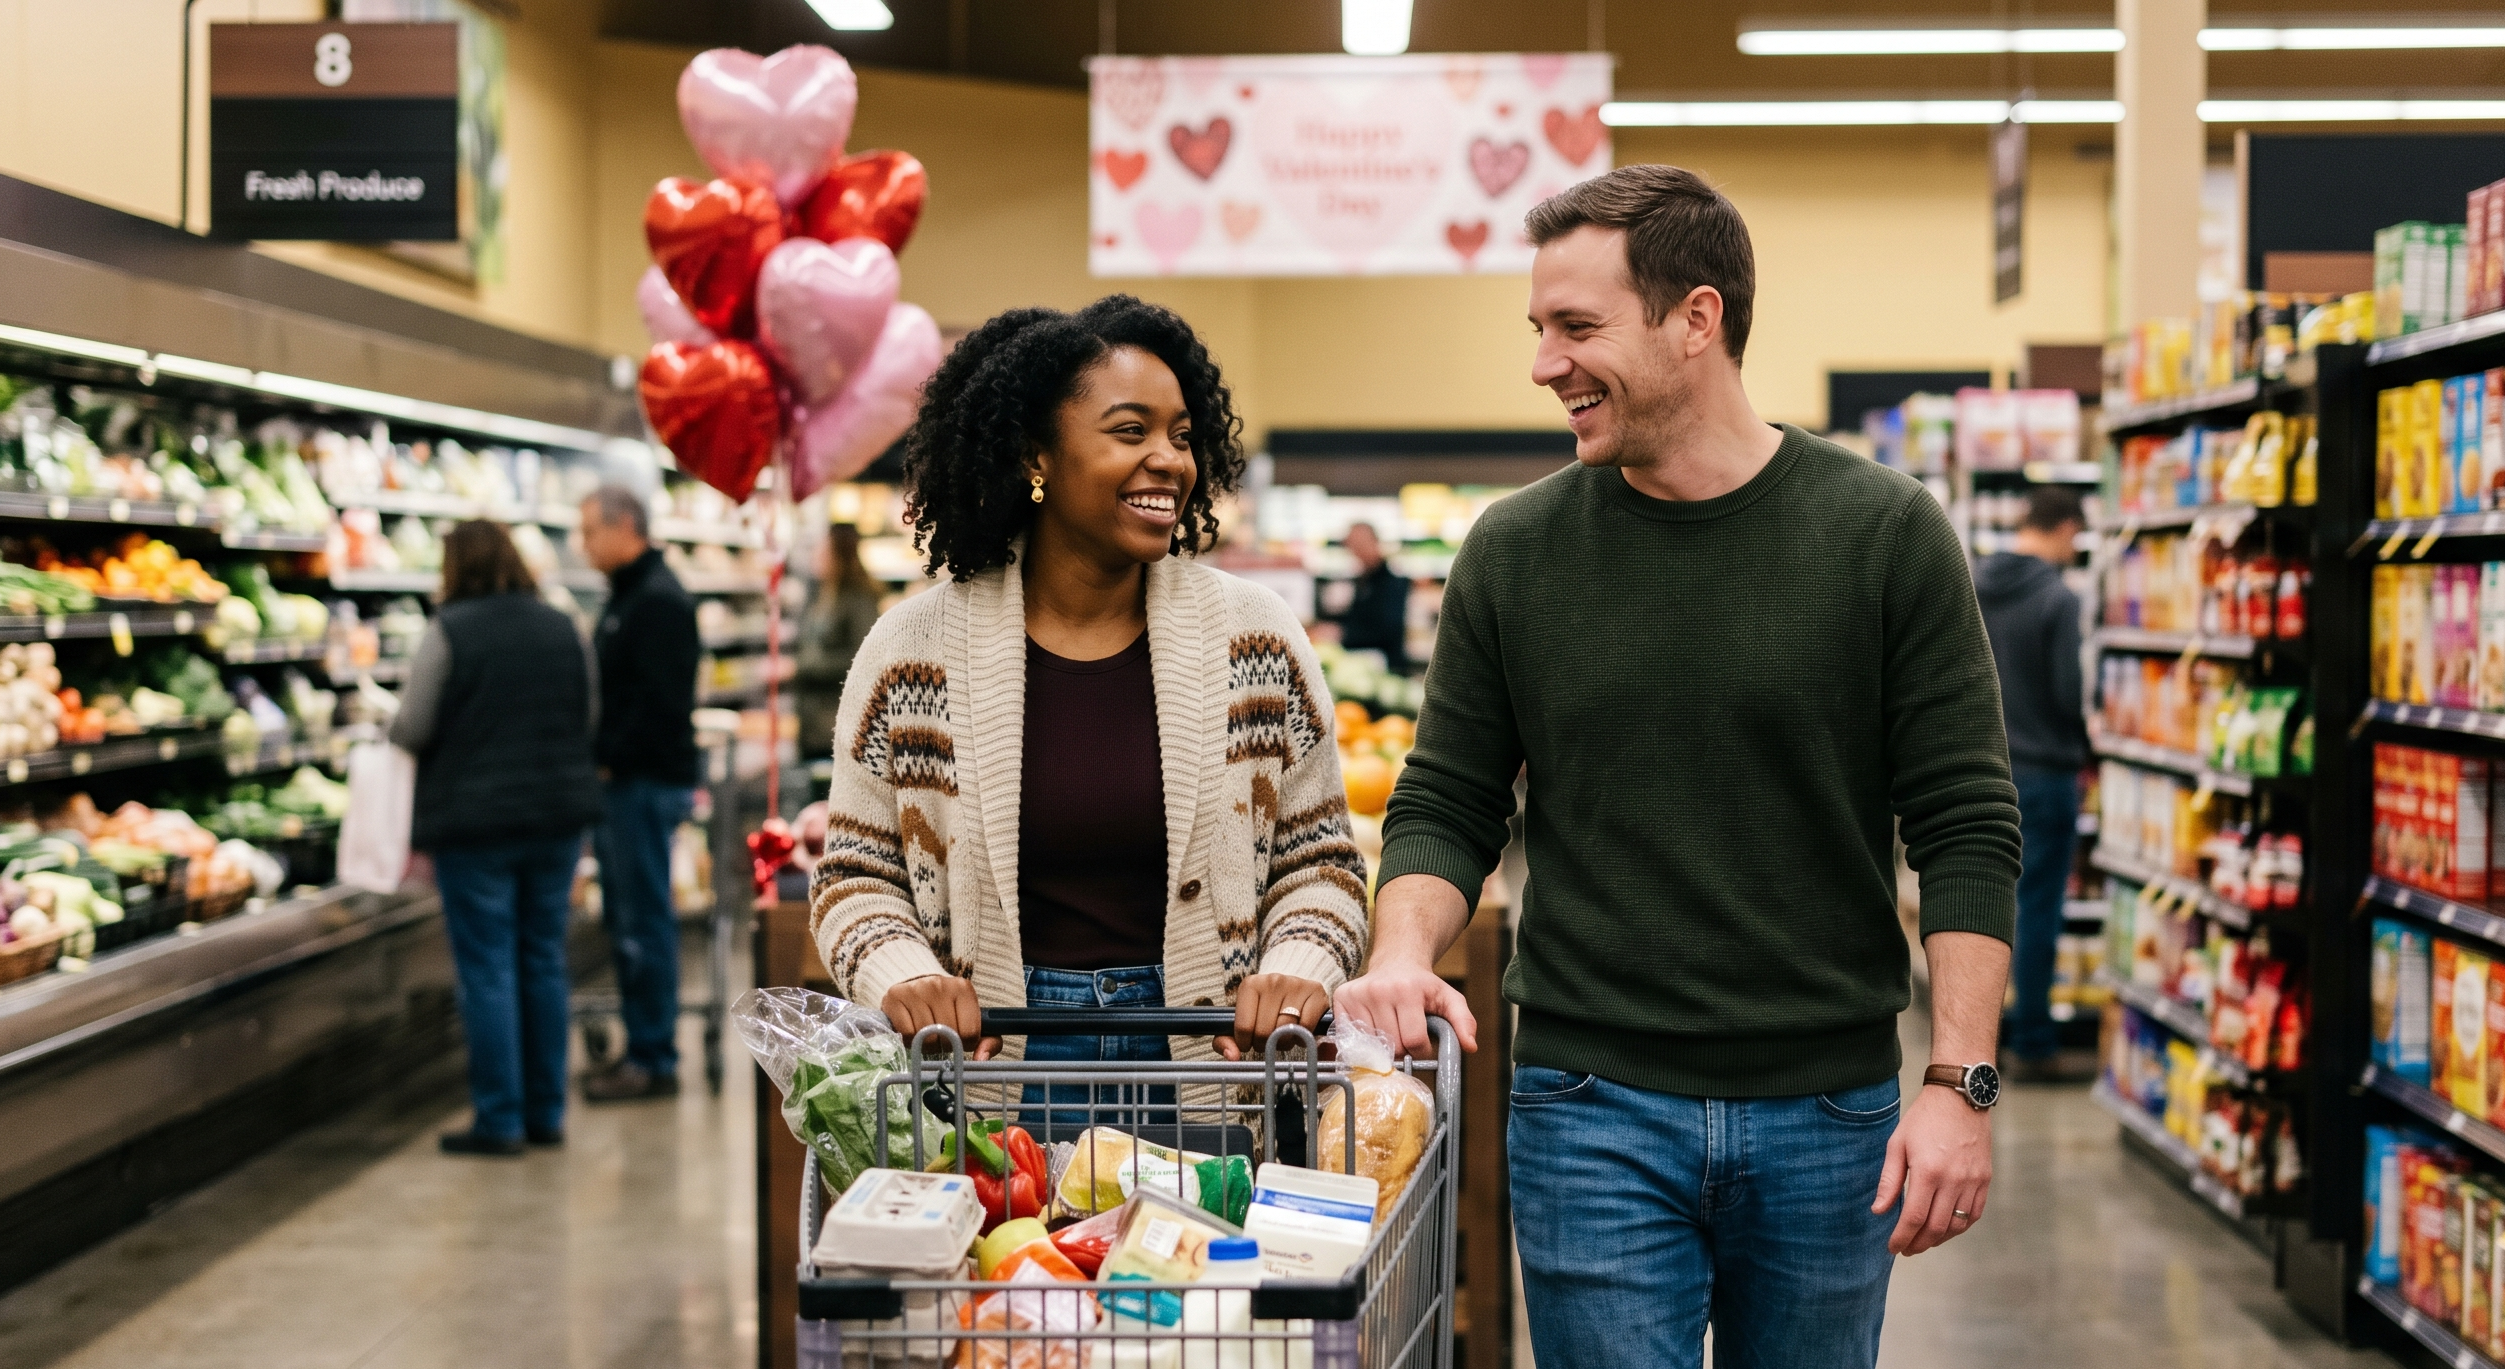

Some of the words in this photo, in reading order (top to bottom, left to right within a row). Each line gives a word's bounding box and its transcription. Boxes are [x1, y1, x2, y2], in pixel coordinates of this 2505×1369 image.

[313, 32, 353, 87] 8
[1294, 119, 1402, 152] Happy
[245, 169, 316, 201] Fresh
[317, 169, 425, 201] Produce
[1263, 155, 1442, 184] Valentine's
[1317, 190, 1382, 223] Day
